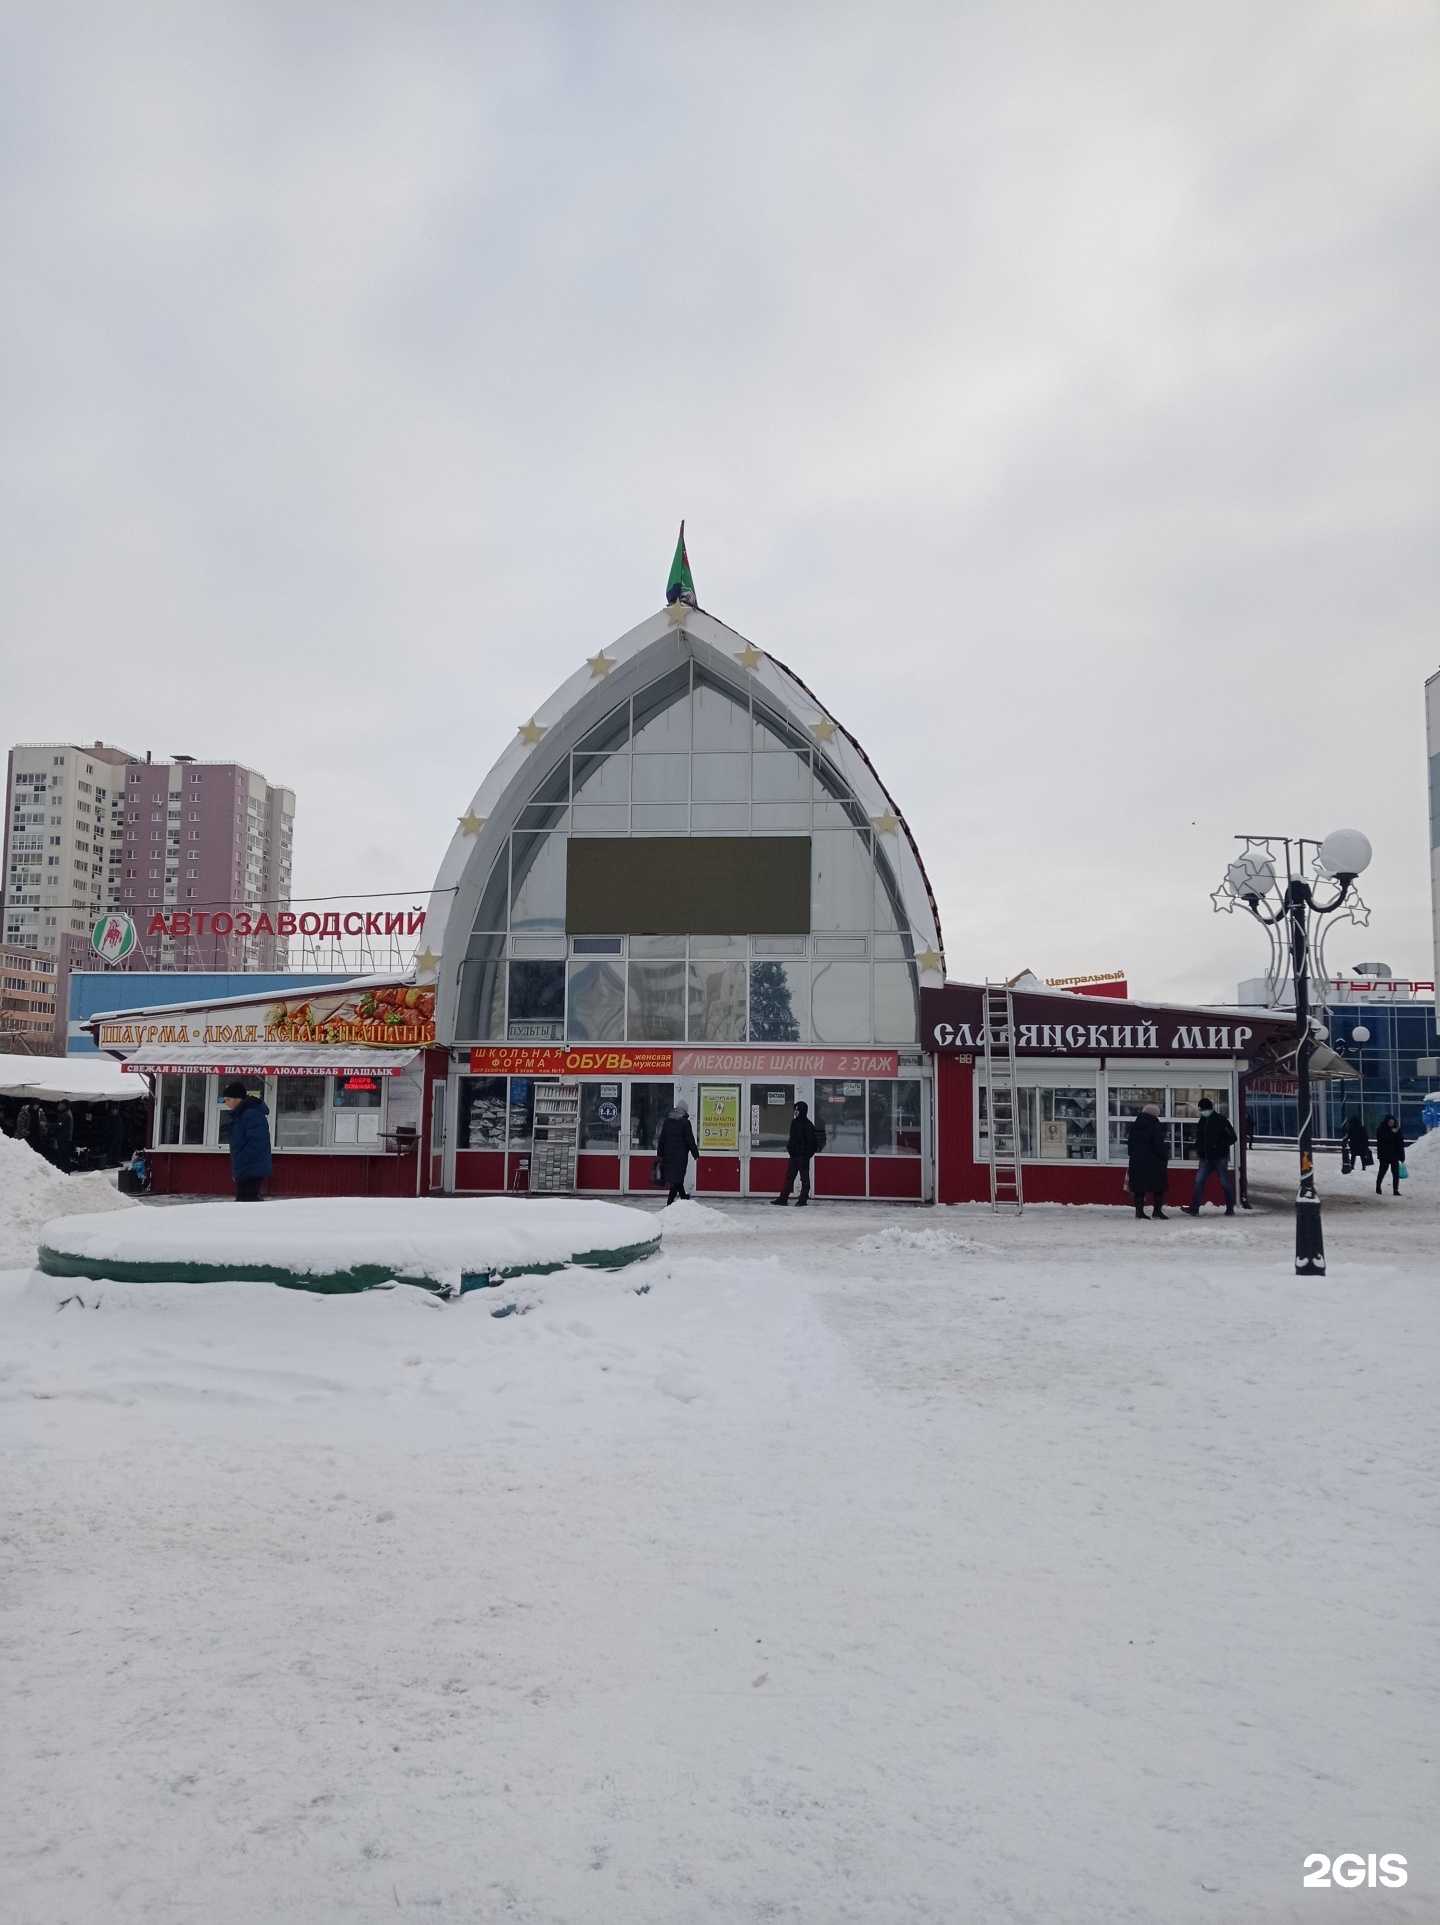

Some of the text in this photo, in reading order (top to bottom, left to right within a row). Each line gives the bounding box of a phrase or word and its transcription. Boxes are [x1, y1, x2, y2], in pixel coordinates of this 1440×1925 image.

[148, 906, 427, 940] АВТОЗАВОДСКИЙ
[1046, 969, 1125, 987] Центральный
[101, 1024, 190, 1047] ШАУРМА
[1171, 1025, 1252, 1050] МИР
[475, 1048, 562, 1058] ШКОЛЬНАЯ
[566, 1053, 633, 1069] ОБУВЬ
[127, 1064, 170, 1073] СВЕЖАЯ
[171, 1065, 219, 1074] ВЫПЕЧКА
[224, 1066, 268, 1074] ШАУРМА
[343, 1068, 393, 1076] ШАШЛЫК
[491, 1058, 545, 1068] ФОРМА
[633, 1061, 672, 1070] мужская
[693, 1055, 766, 1071] МЕХОВЫЕ
[770, 1055, 825, 1071] ШАПКИ
[837, 1055, 850, 1071] 2
[851, 1055, 893, 1072] ЭТАЖ
